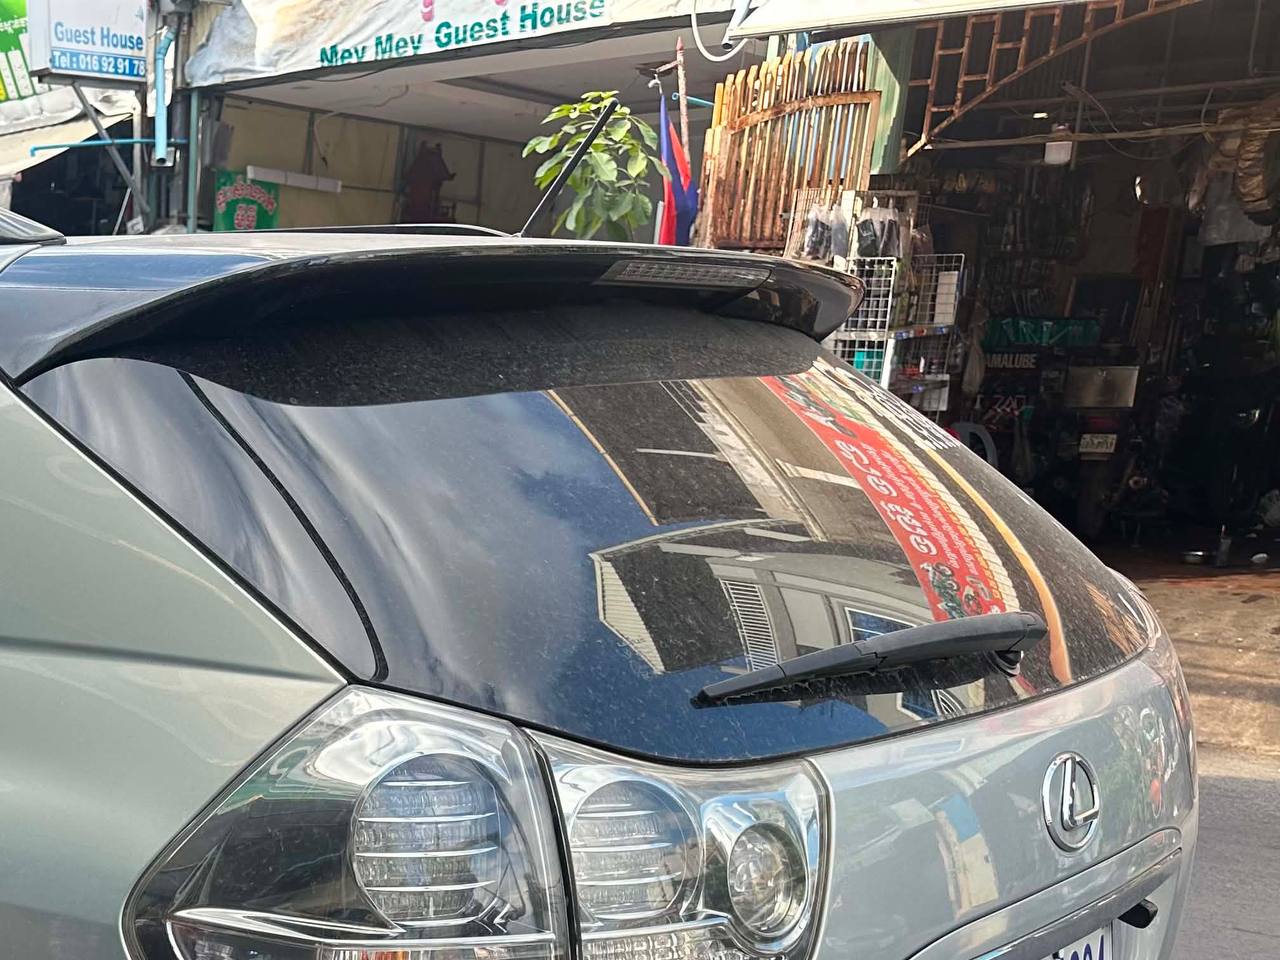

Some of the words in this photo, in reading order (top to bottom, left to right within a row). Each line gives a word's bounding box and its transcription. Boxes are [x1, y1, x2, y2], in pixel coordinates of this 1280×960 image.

[54, 22, 96, 46] Guest
[100, 27, 143, 50] House
[435, 10, 510, 49] Guest
[519, 0, 605, 32] House
[53, 51, 71, 67] Tel
[80, 55, 99, 71] 016
[102, 57, 115, 72] 92
[117, 58, 130, 74] 91
